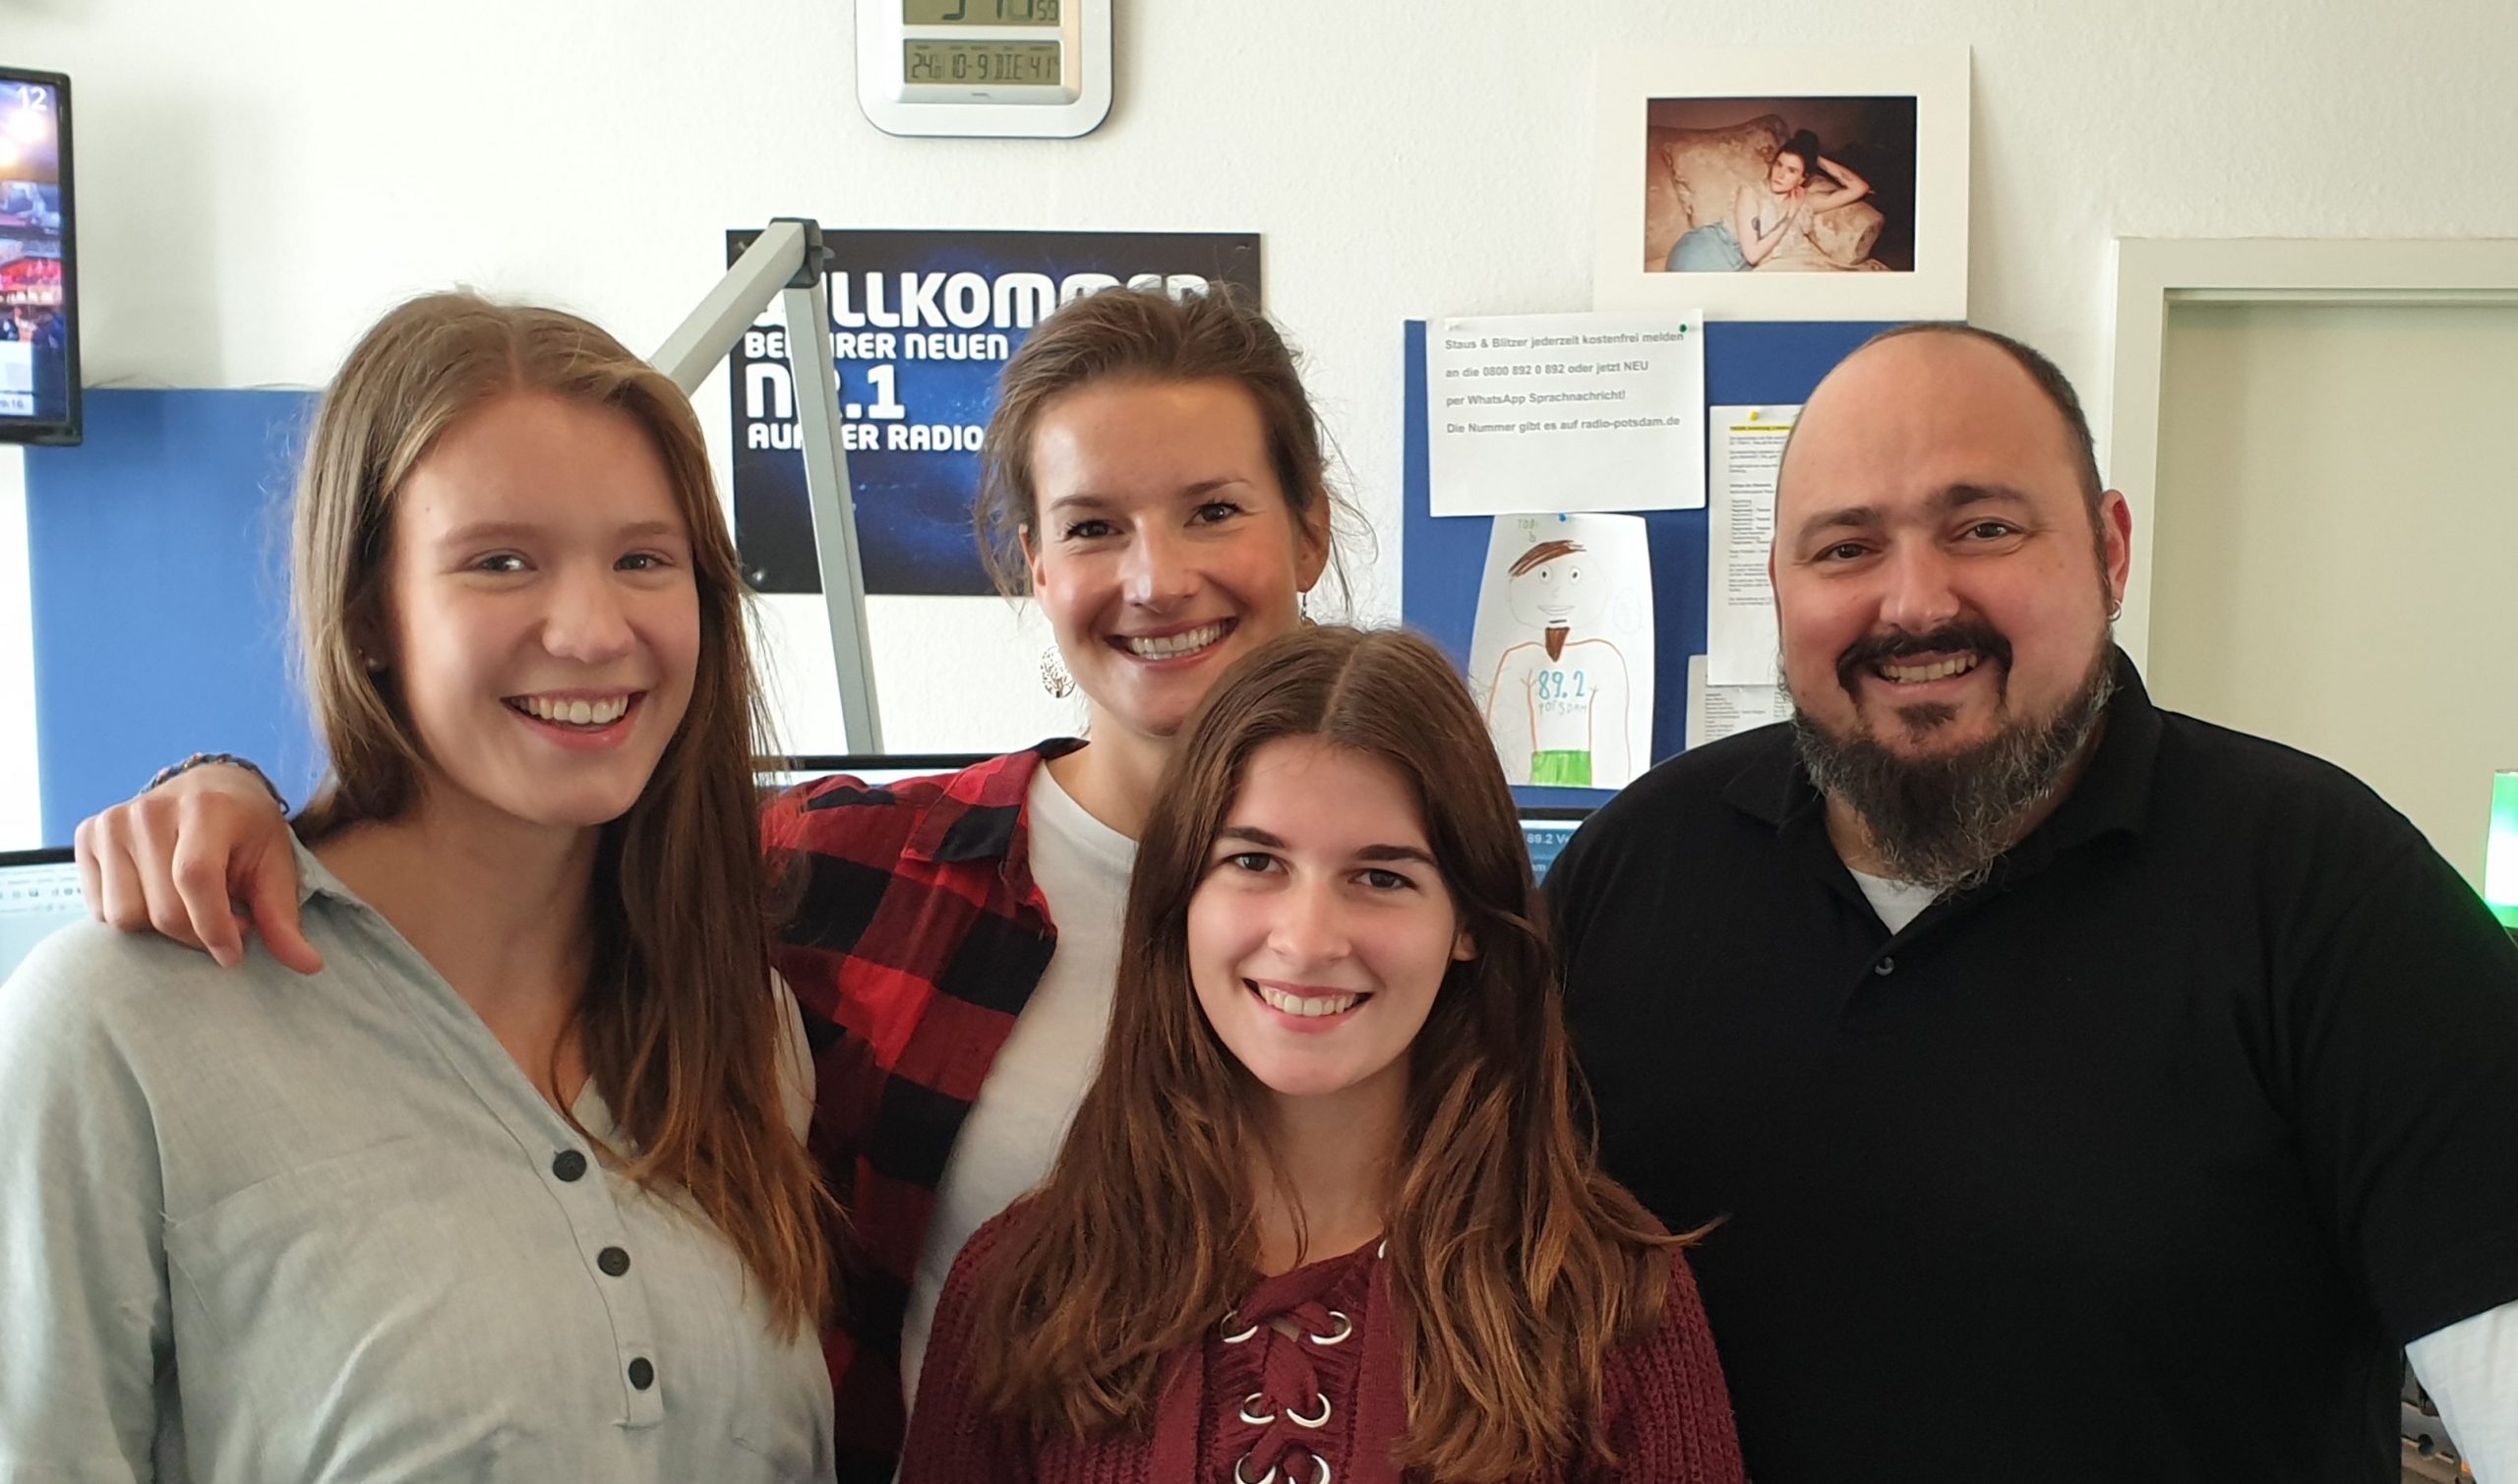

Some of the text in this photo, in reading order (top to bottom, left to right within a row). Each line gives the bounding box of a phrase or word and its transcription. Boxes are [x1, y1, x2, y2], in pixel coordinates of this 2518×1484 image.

[17, 86, 47, 110] 12
[752, 270, 1211, 329] LLKOM
[904, 333, 1009, 361] NEUEN
[1445, 331, 1684, 350] Staus & Blitzer jederzeit kostenfrei melden
[1463, 368, 1479, 378] die
[1482, 366, 1509, 376] 0800
[1512, 365, 1532, 375] 892
[1534, 365, 1542, 375] 0
[1544, 364, 1565, 374] 892
[1567, 363, 1593, 373] oder
[1595, 361, 1621, 375] jetzt
[1623, 361, 1649, 371] NEU
[745, 361, 906, 420] N.1
[1446, 389, 1626, 408] per WhatsApp Sprachnachricht!
[1447, 416, 1681, 434] Die Nummer gibt es auf radio-potsdam.de
[1538, 670, 1586, 700] 89.2
[1526, 833, 1554, 844] 89.2
